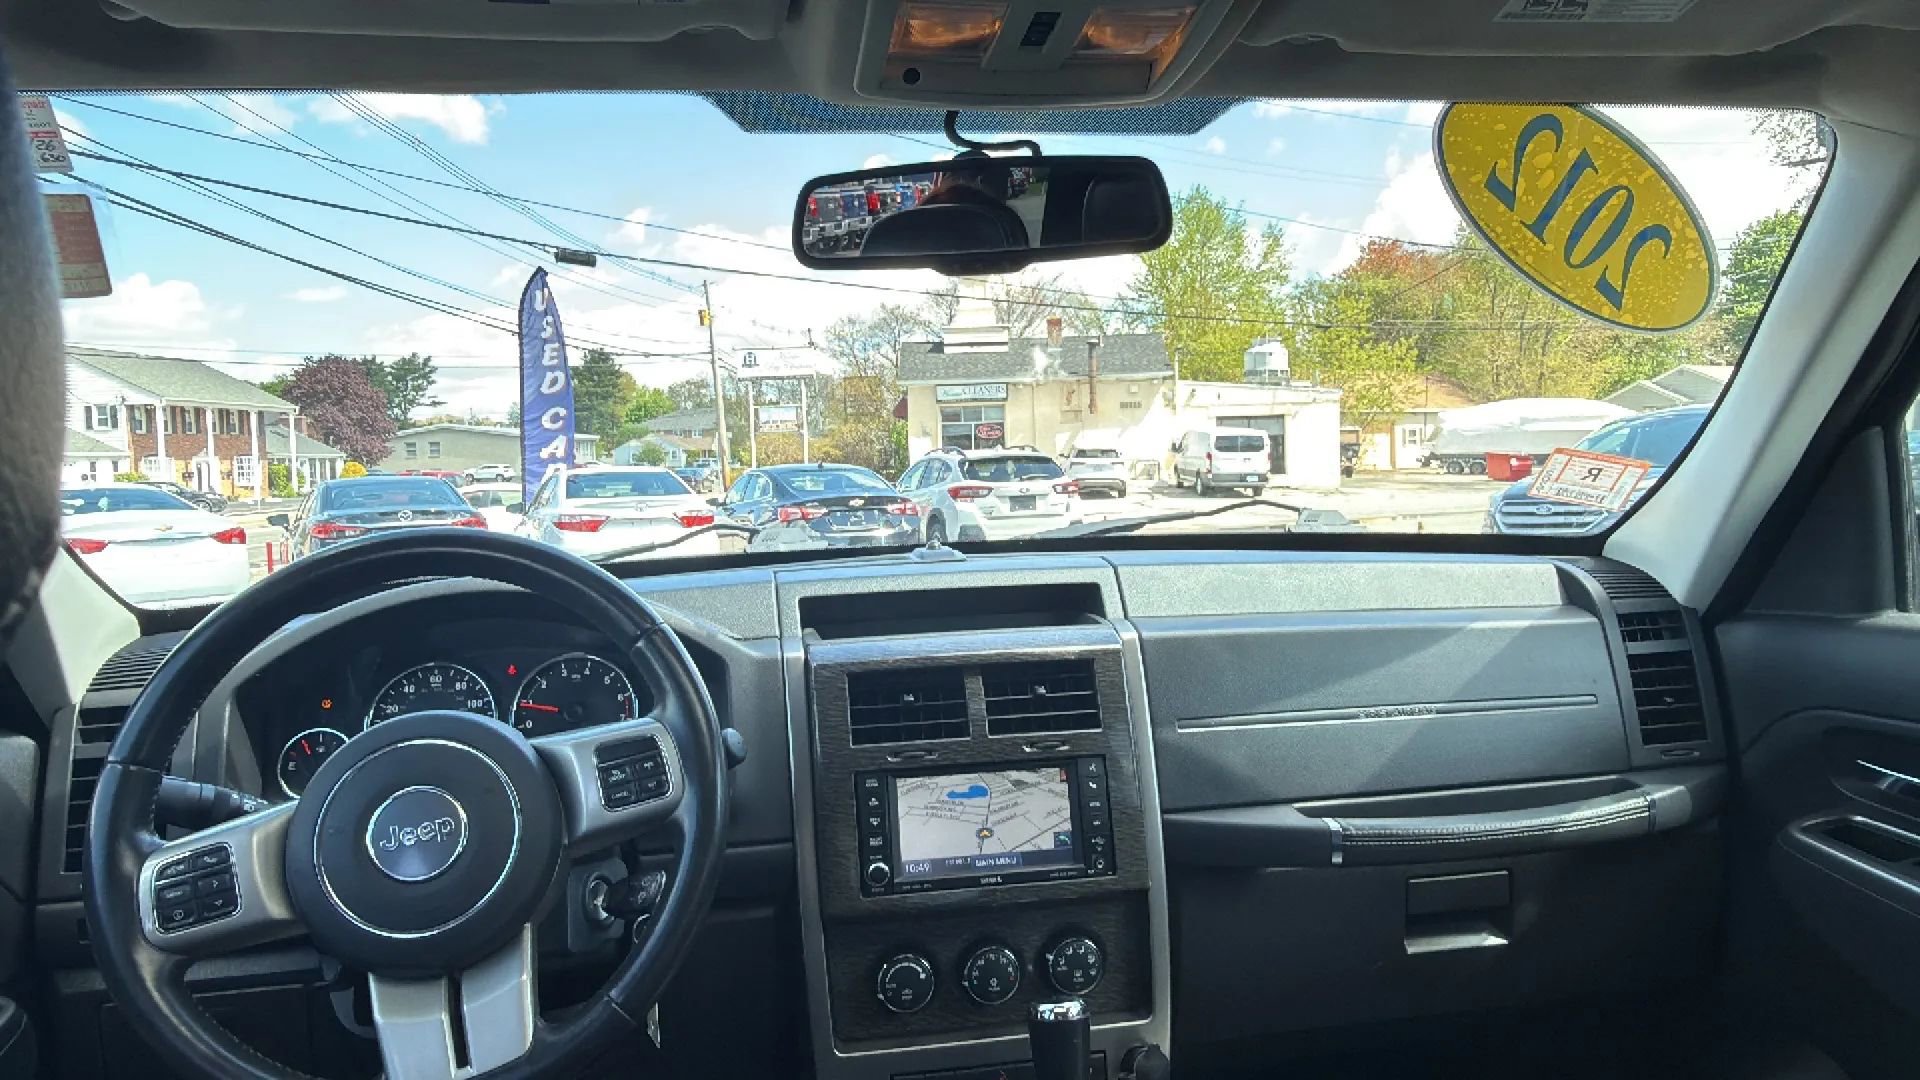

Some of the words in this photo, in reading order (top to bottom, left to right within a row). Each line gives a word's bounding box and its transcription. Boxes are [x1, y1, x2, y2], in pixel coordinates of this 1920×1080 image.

[534, 287, 566, 394] USED
[561, 668, 568, 677] 3
[583, 667, 591, 675] 4
[430, 674, 442, 683] 60
[604, 675, 611, 685] 5
[403, 684, 415, 693] 40
[455, 681, 467, 690] 80
[541, 680, 547, 689] 2
[467, 699, 483, 708] 100
[385, 704, 399, 713] 20
[525, 719, 533, 728] 0
[287, 761, 297, 771] E
[379, 816, 455, 851] Jeep
[975, 858, 995, 867] MAIN
[995, 856, 1017, 866] MENU
[905, 862, 930, 873] 10:49
